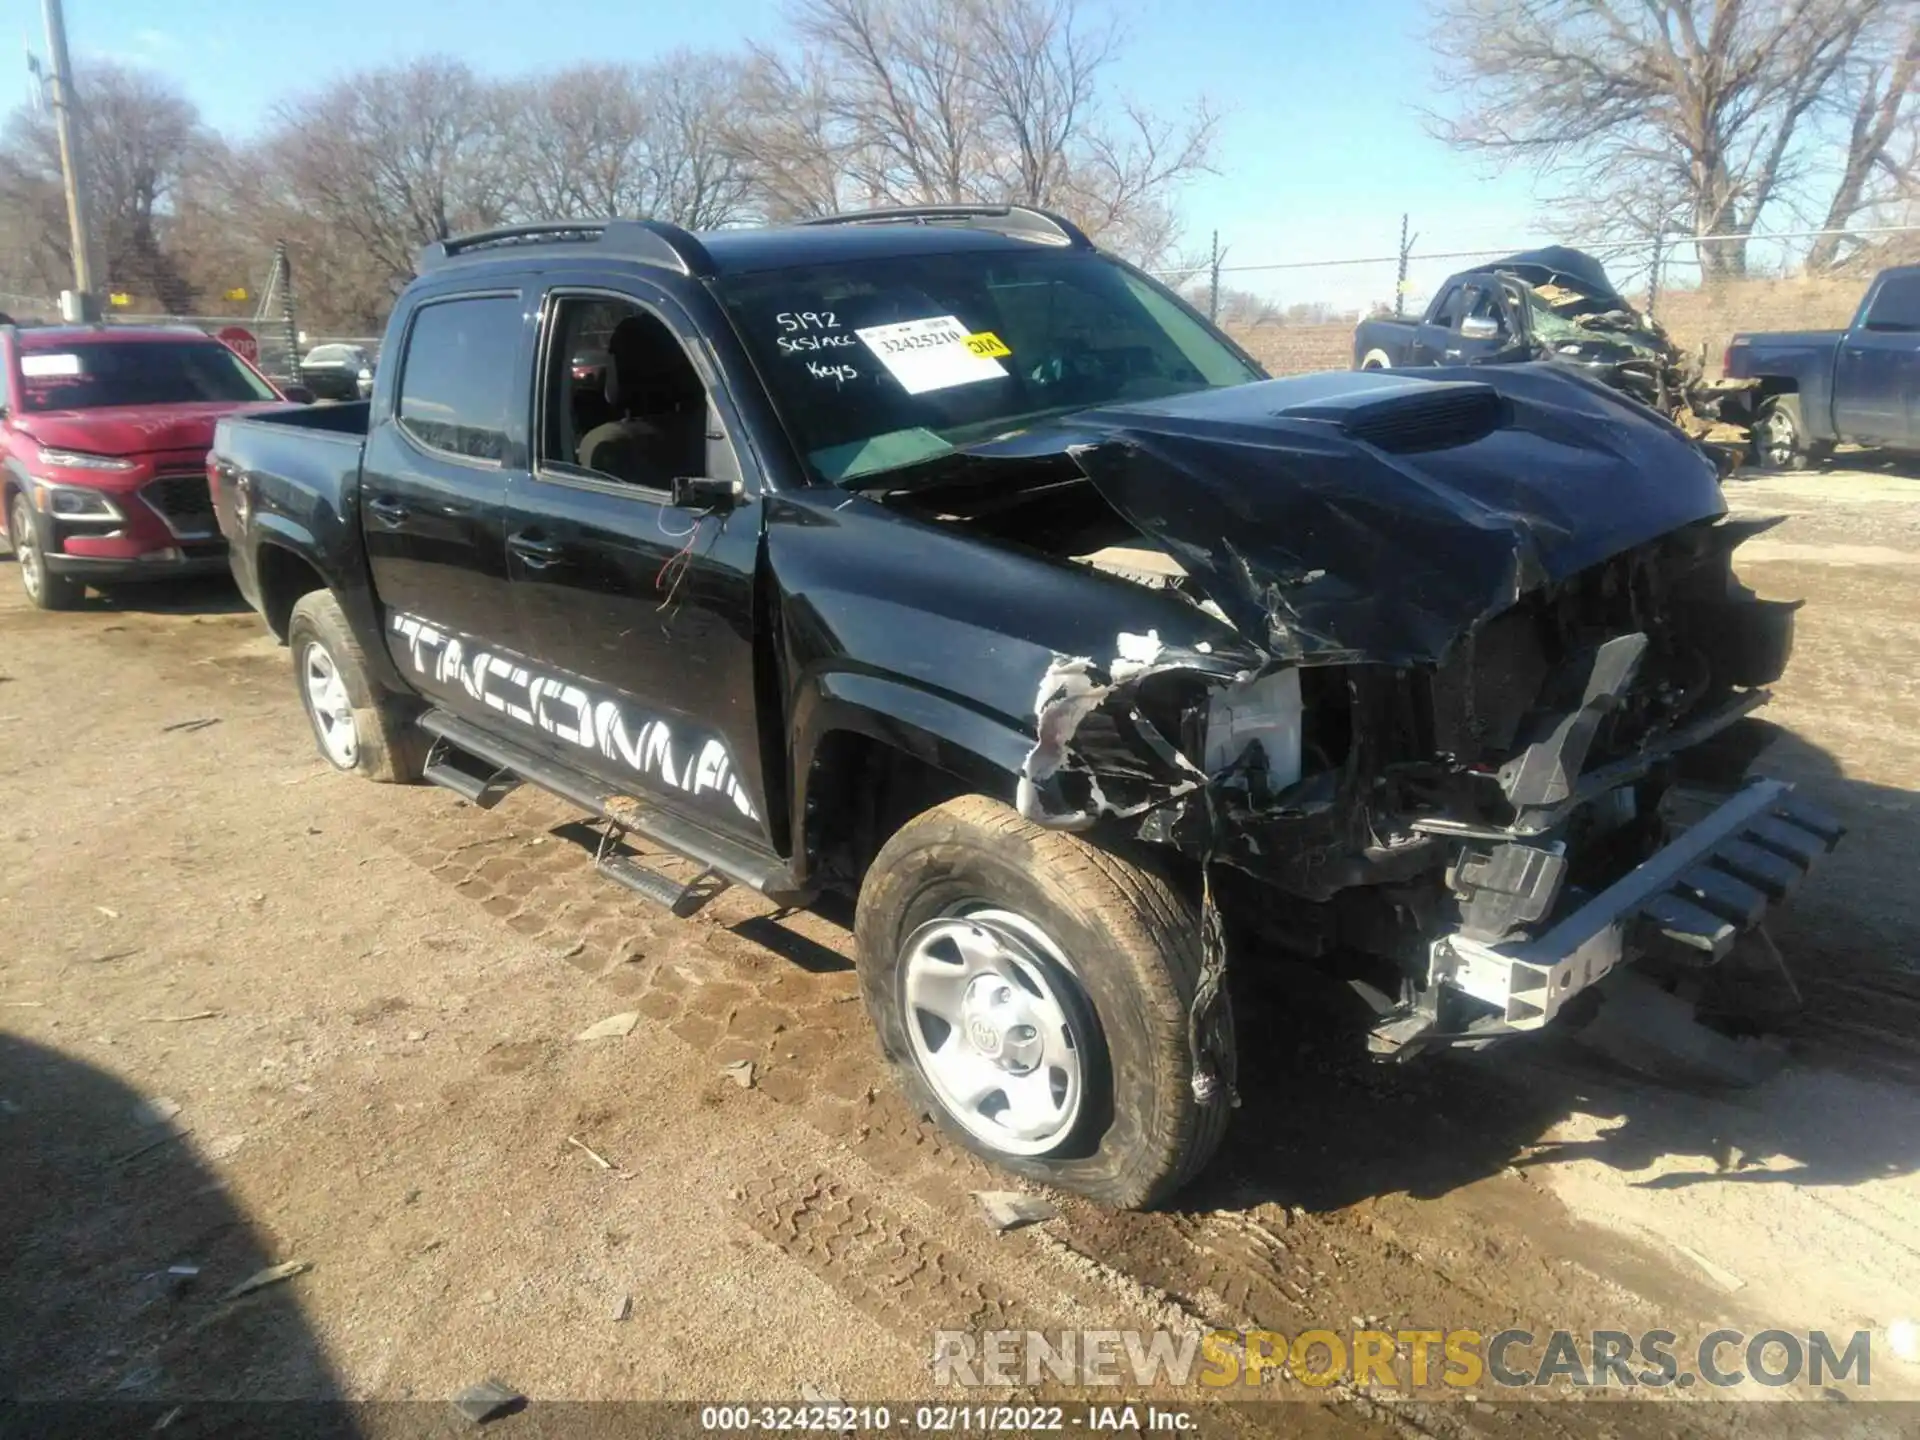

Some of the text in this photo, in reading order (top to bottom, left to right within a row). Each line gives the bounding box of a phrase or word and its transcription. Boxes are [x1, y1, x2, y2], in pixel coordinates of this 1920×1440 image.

[775, 311, 842, 332] 5192
[881, 329, 960, 354] 32425210
[393, 612, 760, 822] TACOMA
